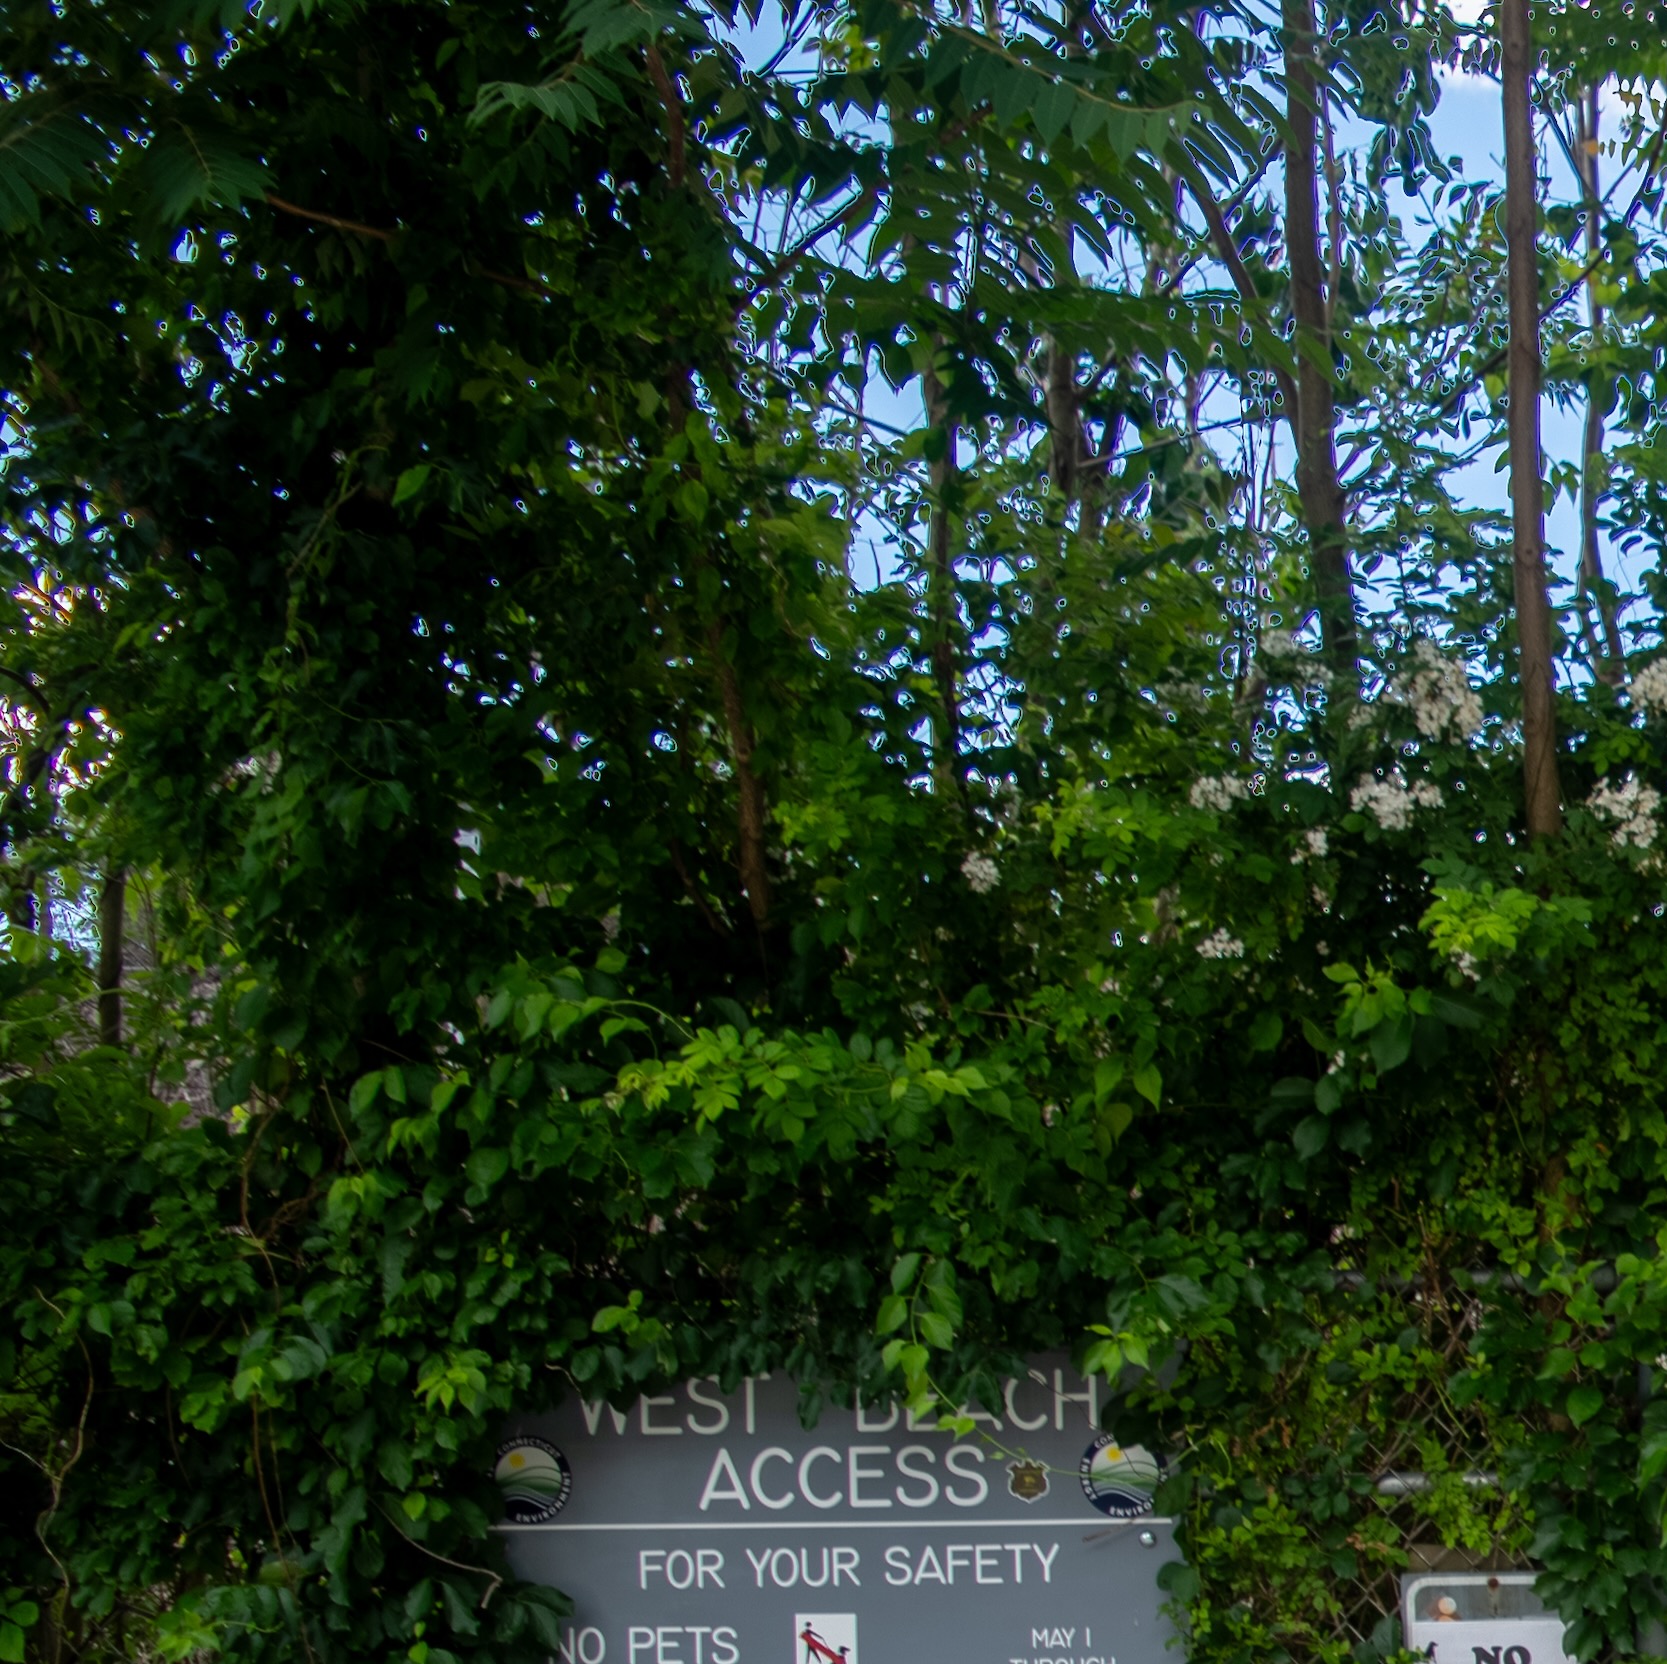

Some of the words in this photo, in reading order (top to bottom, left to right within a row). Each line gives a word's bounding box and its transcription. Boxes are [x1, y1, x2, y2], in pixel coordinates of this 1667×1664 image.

[699, 1445, 989, 1510] ACCESS
[638, 1549, 726, 1590] FOR
[745, 1546, 861, 1588] YOUR
[885, 1543, 1059, 1584] SAFETY
[1031, 1626, 1076, 1649] MAY
